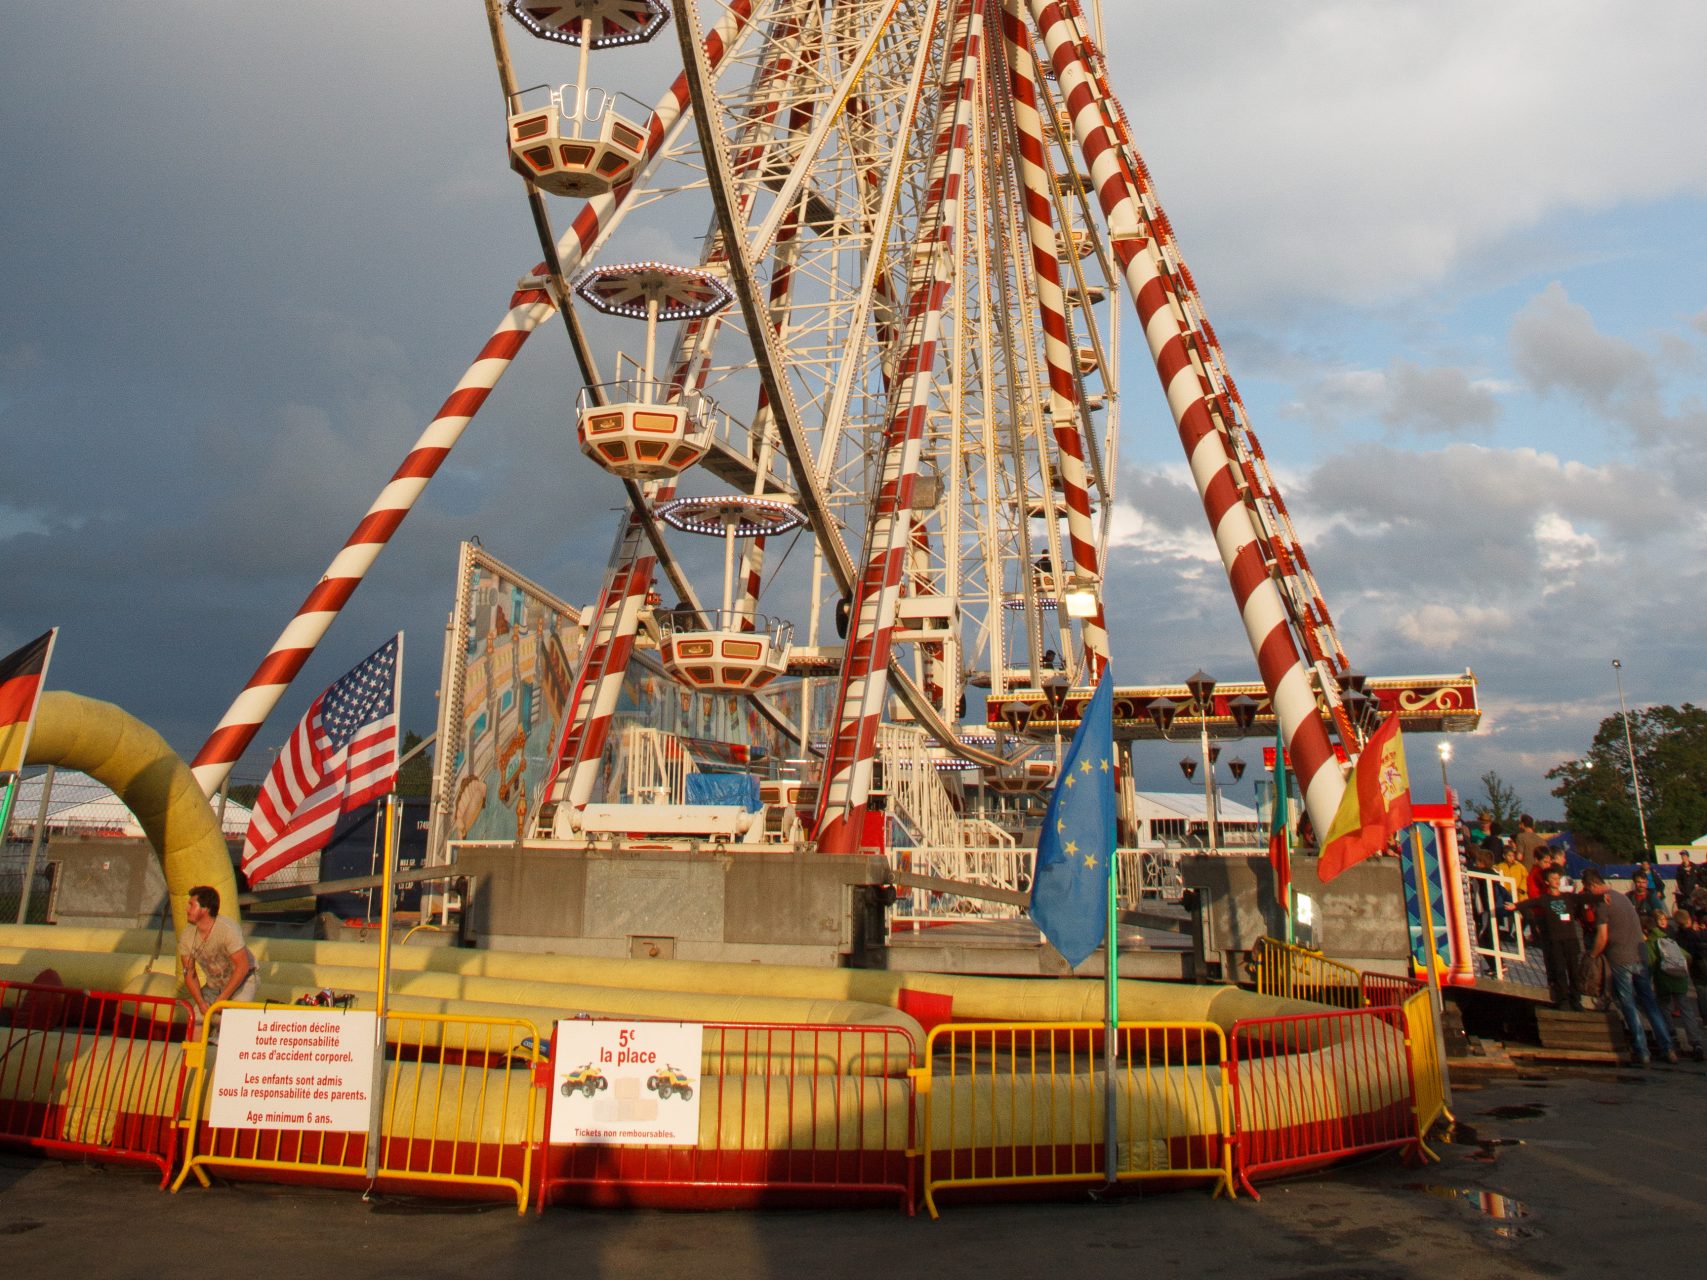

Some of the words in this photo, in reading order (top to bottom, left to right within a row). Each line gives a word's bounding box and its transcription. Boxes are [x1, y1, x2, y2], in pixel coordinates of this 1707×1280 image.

[257, 1021, 267, 1032] La
[270, 1021, 307, 1033] direction
[309, 1022, 340, 1033] décline
[255, 1036, 277, 1046] toute
[279, 1036, 340, 1048] responsabilité
[619, 1029, 635, 1048] 5€
[239, 1051, 249, 1060] en
[251, 1051, 266, 1060] cas
[268, 1050, 312, 1061] d'accident
[314, 1051, 353, 1064] corporel.
[600, 1047, 612, 1063] la
[617, 1047, 656, 1067] place
[244, 1073, 259, 1084] Les
[262, 1073, 293, 1085] enfants
[295, 1075, 315, 1086] sont
[317, 1075, 343, 1086] admis
[218, 1088, 238, 1097] sous
[240, 1086, 248, 1097] la
[250, 1087, 311, 1100] responsabilité
[313, 1088, 328, 1100] des
[330, 1090, 367, 1102] parents.
[246, 1110, 263, 1125] Age
[265, 1111, 304, 1123] minimum
[307, 1112, 313, 1123] 6
[314, 1114, 333, 1124] ans.
[575, 1128, 601, 1137] Tickets
[603, 1129, 617, 1138] non
[619, 1128, 676, 1139] remboursables.
